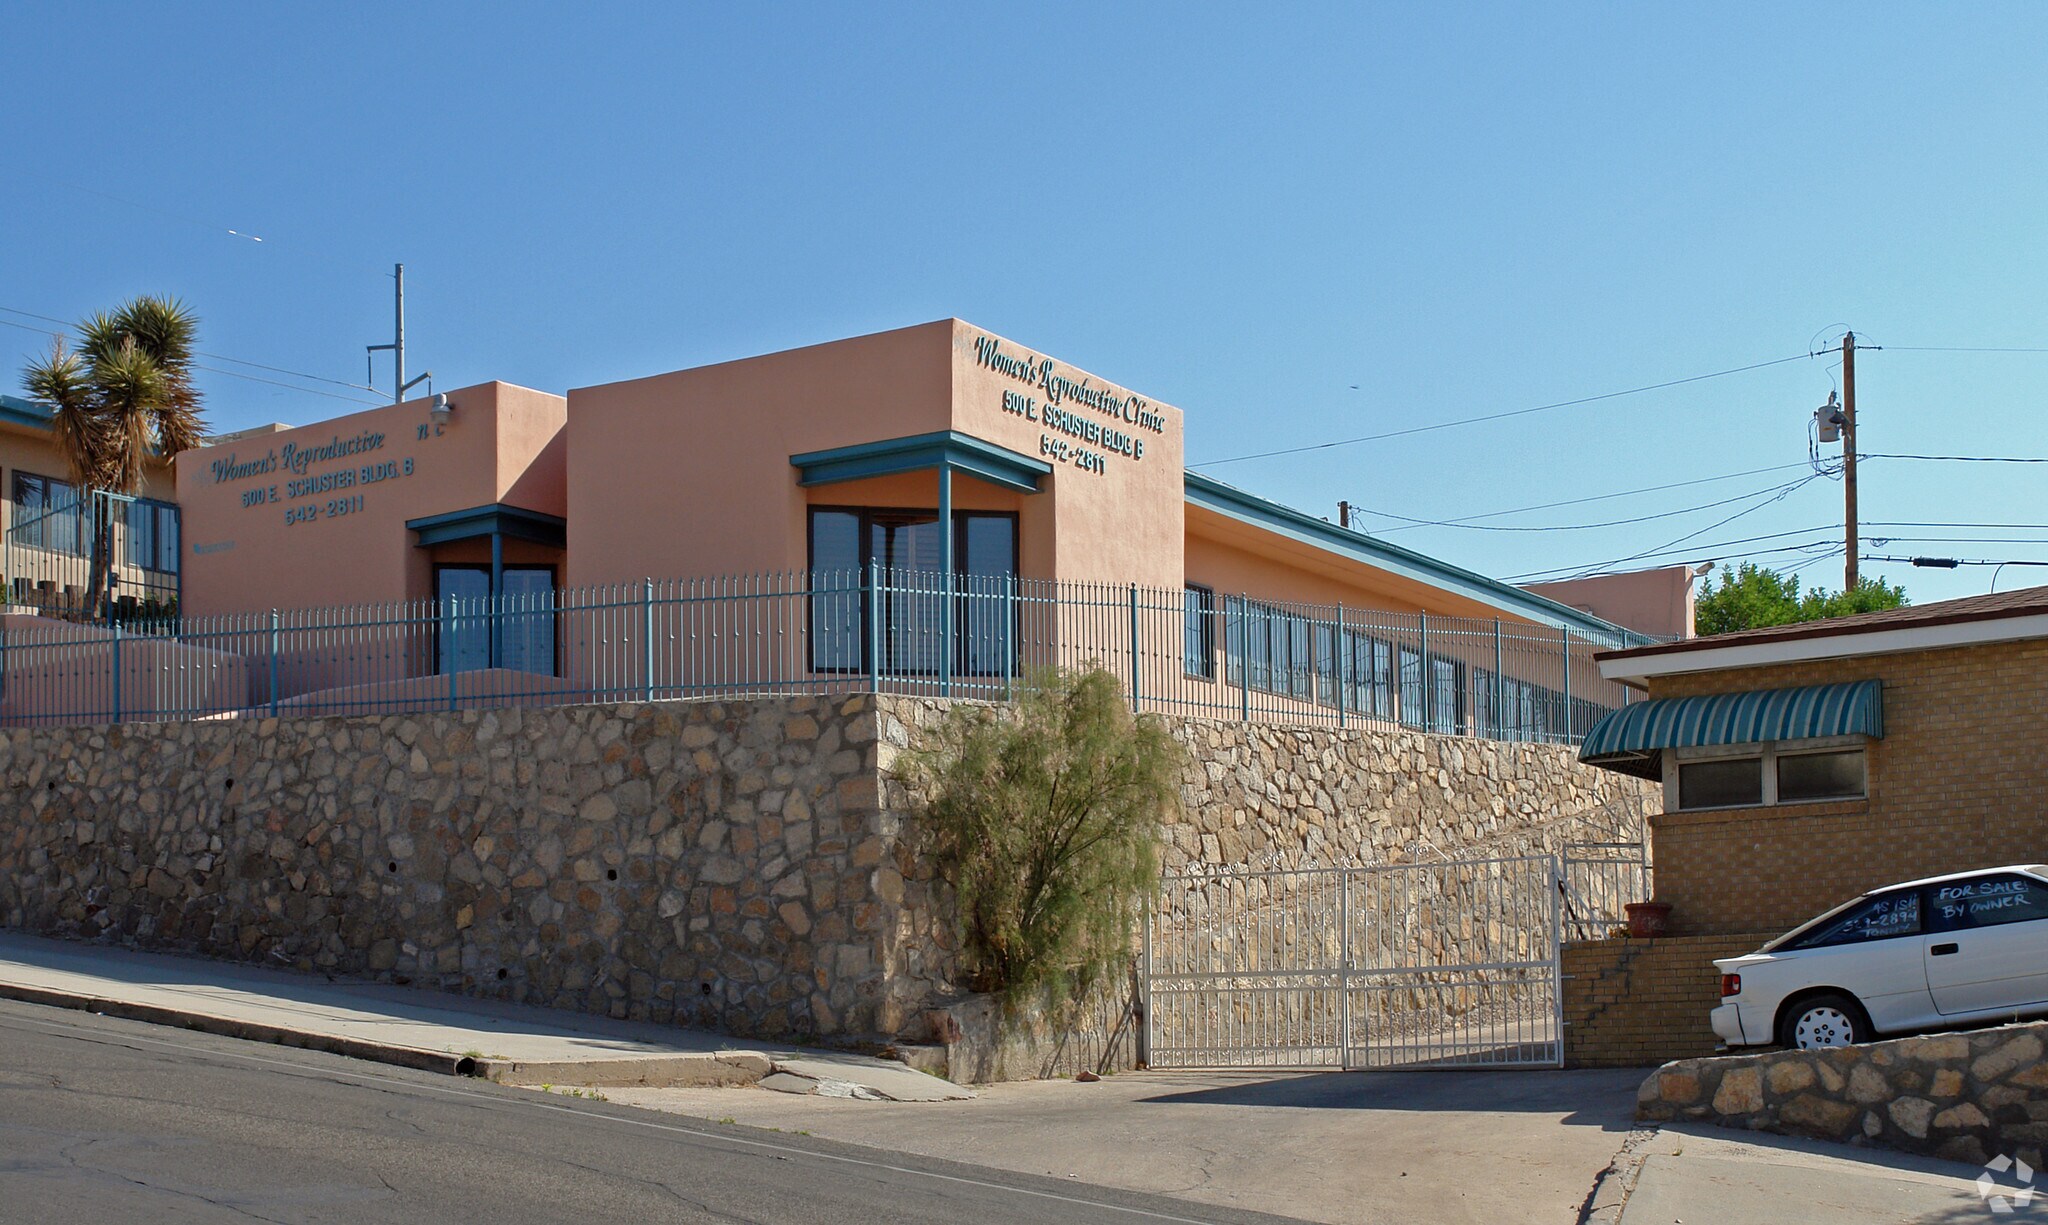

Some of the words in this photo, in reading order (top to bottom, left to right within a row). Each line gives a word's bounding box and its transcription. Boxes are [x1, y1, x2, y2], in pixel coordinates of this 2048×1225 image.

[975, 335, 1038, 385] Women's
[1038, 358, 1123, 418] Reproductive
[1122, 396, 1166, 434] Clinic
[1002, 389, 1025, 416] 500
[1041, 403, 1101, 446] SCHUSTER
[1133, 439, 1144, 461] B
[211, 453, 277, 484] Women's
[280, 430, 385, 475] Reproductive
[1039, 434, 1106, 475] 542-2811
[241, 487, 265, 508] 500
[287, 469, 356, 498] SCHUSTER
[360, 458, 400, 484] BLDG.
[402, 457, 414, 476] B
[285, 495, 363, 526] 542-2811
[1872, 900, 1890, 914] AS
[1939, 884, 1974, 901] FOR
[1979, 879, 2029, 896] SALE!
[1942, 903, 1965, 918] BY
[1970, 895, 2031, 914] OWNER
